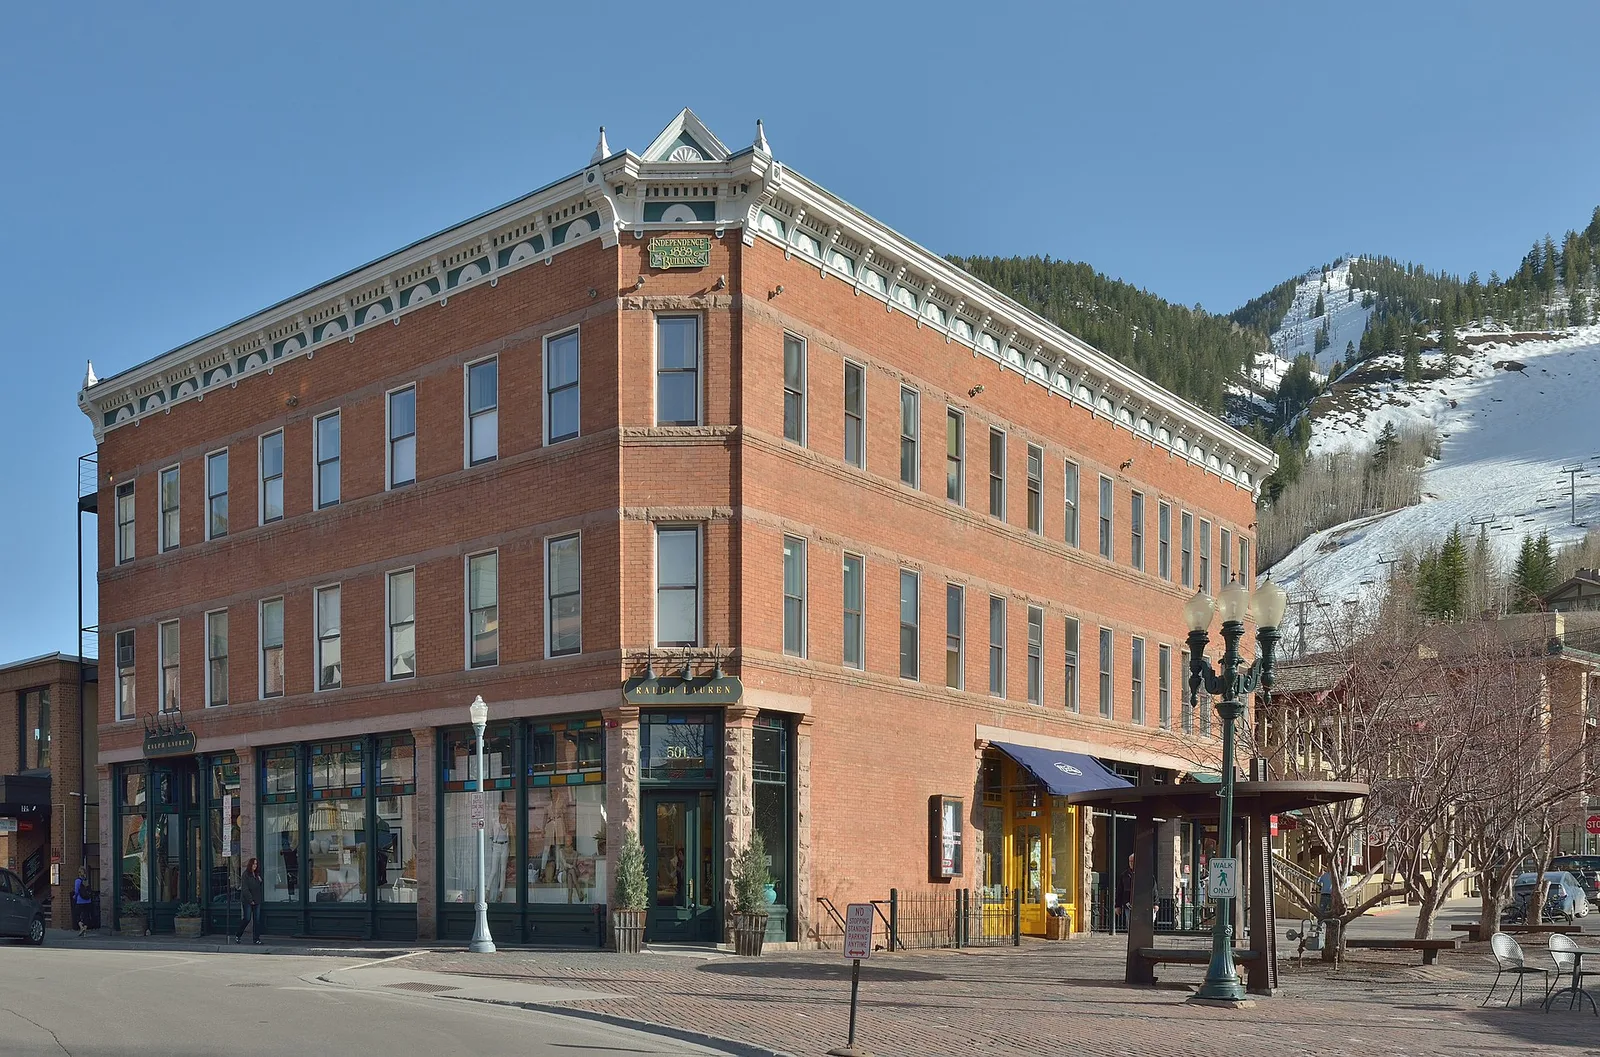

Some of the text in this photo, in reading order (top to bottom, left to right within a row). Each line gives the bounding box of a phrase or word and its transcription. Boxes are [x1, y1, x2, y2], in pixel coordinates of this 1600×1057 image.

[652, 237, 704, 250] INDEPENDENCE
[670, 247, 692, 257] 1889
[661, 256, 697, 269] BUILDING
[636, 686, 731, 694] RALPH LAUREN
[667, 745, 687, 758] 501
[855, 907, 864, 916] NO
